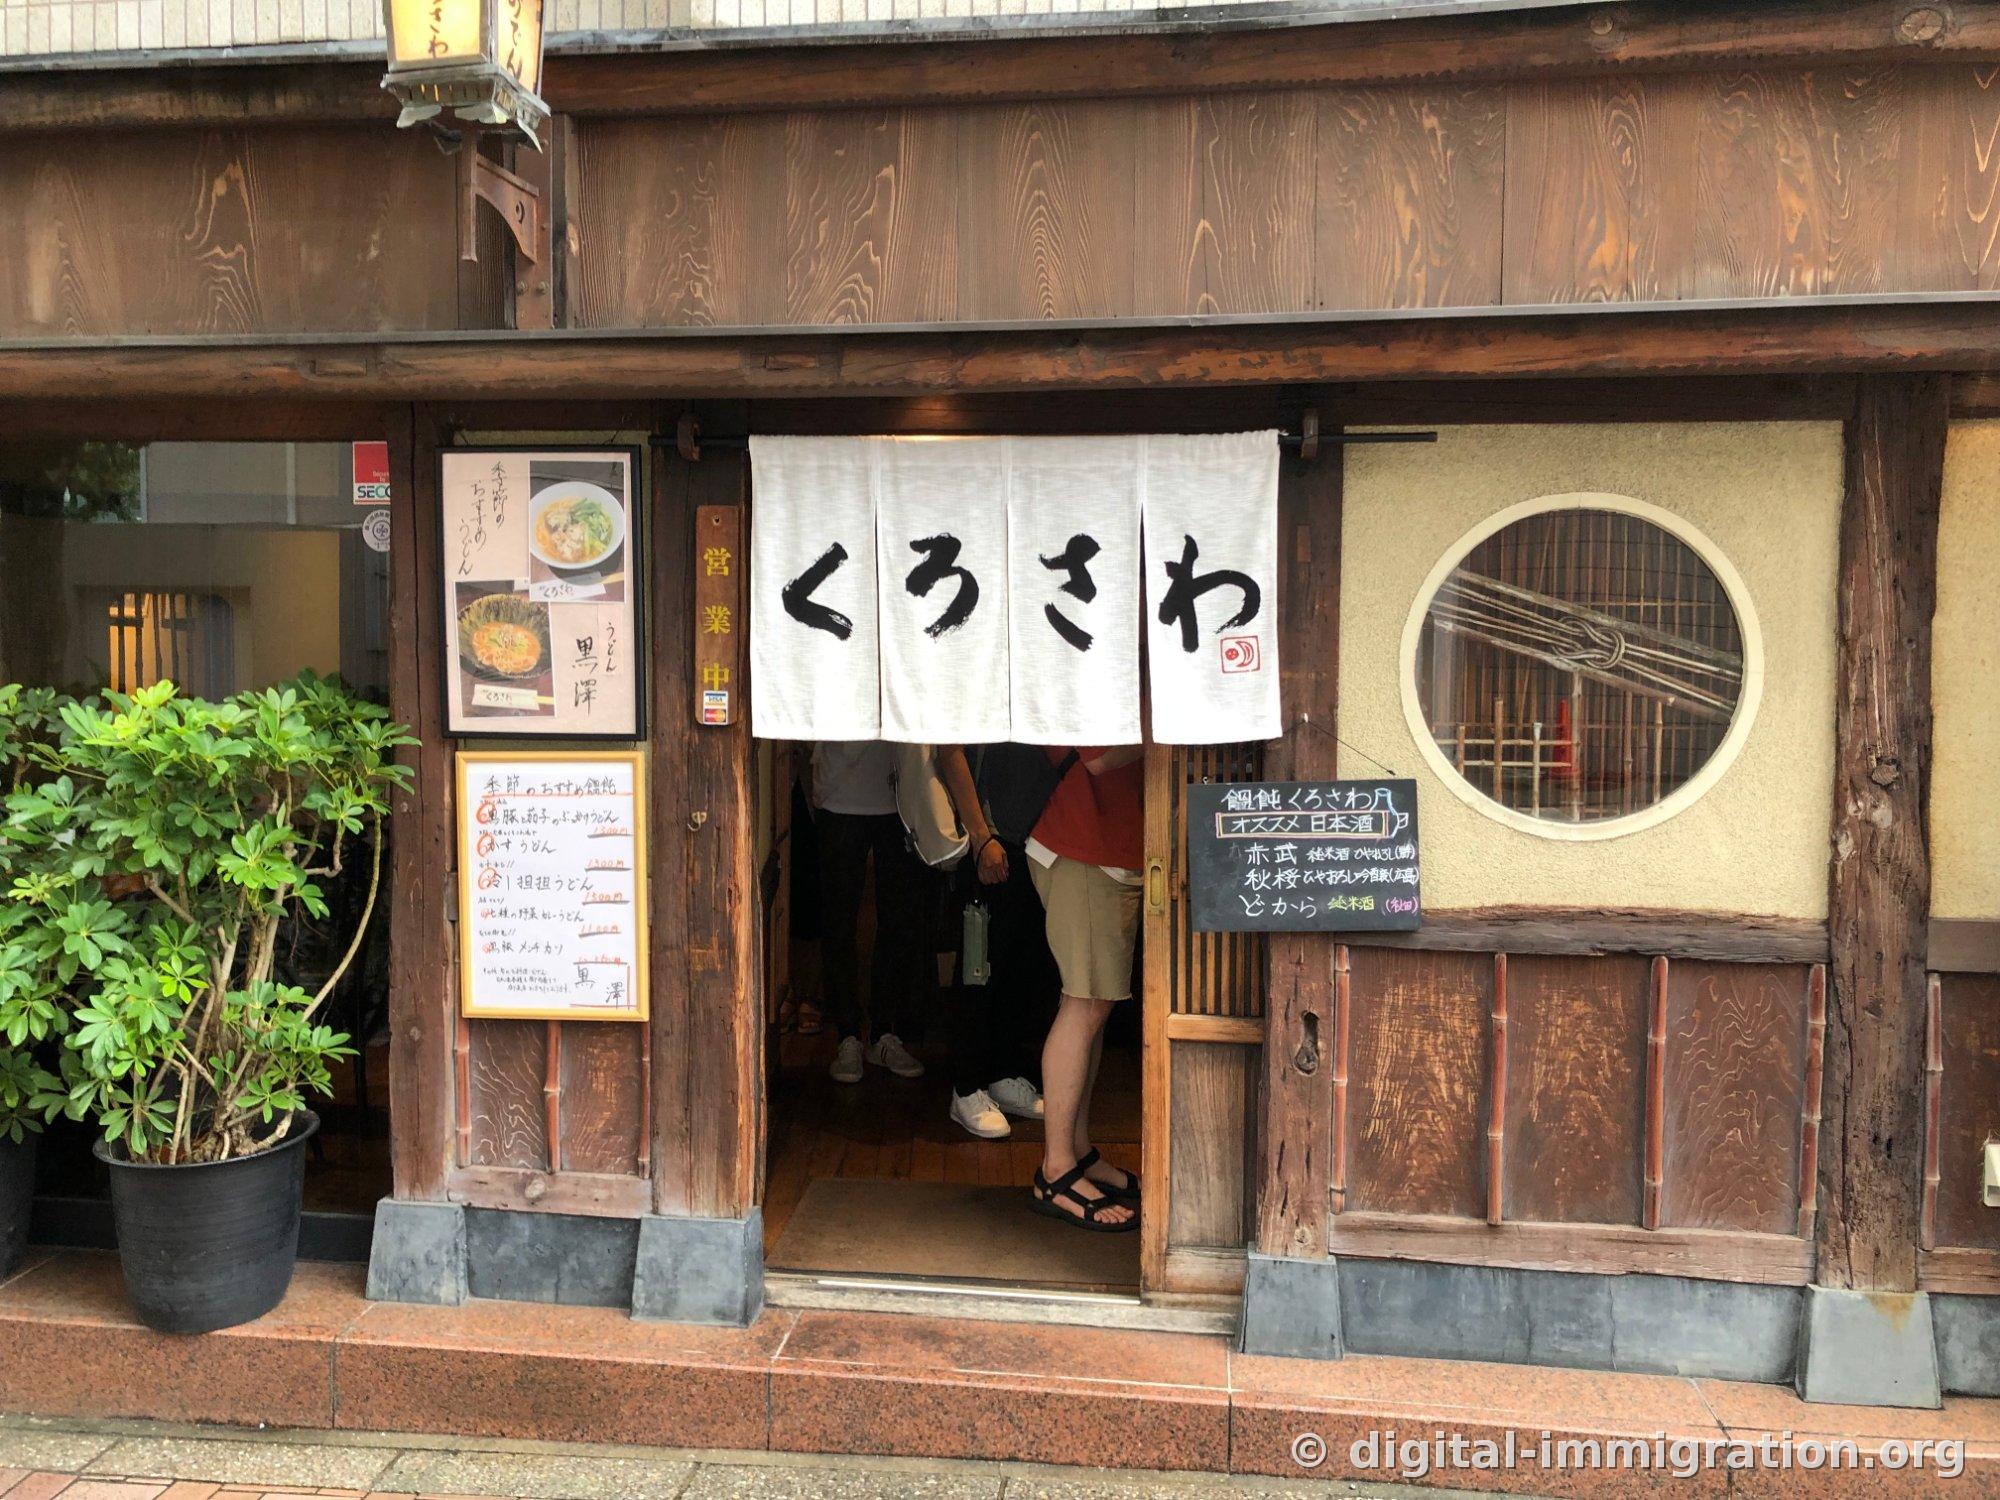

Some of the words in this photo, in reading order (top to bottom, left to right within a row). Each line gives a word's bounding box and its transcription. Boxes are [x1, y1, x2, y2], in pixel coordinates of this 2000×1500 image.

[428, 0, 449, 59] さわ
[458, 518, 473, 575] うどん
[703, 547, 731, 691] 営業中
[781, 532, 1262, 653] くろさわ
[605, 621, 617, 672] うどん
[572, 636, 600, 715] 黒澤
[1310, 814, 1374, 832] 日本酒
[1243, 867, 1302, 891] 秋桜
[1244, 842, 1299, 866] 赤武
[1239, 893, 1318, 919] どから
